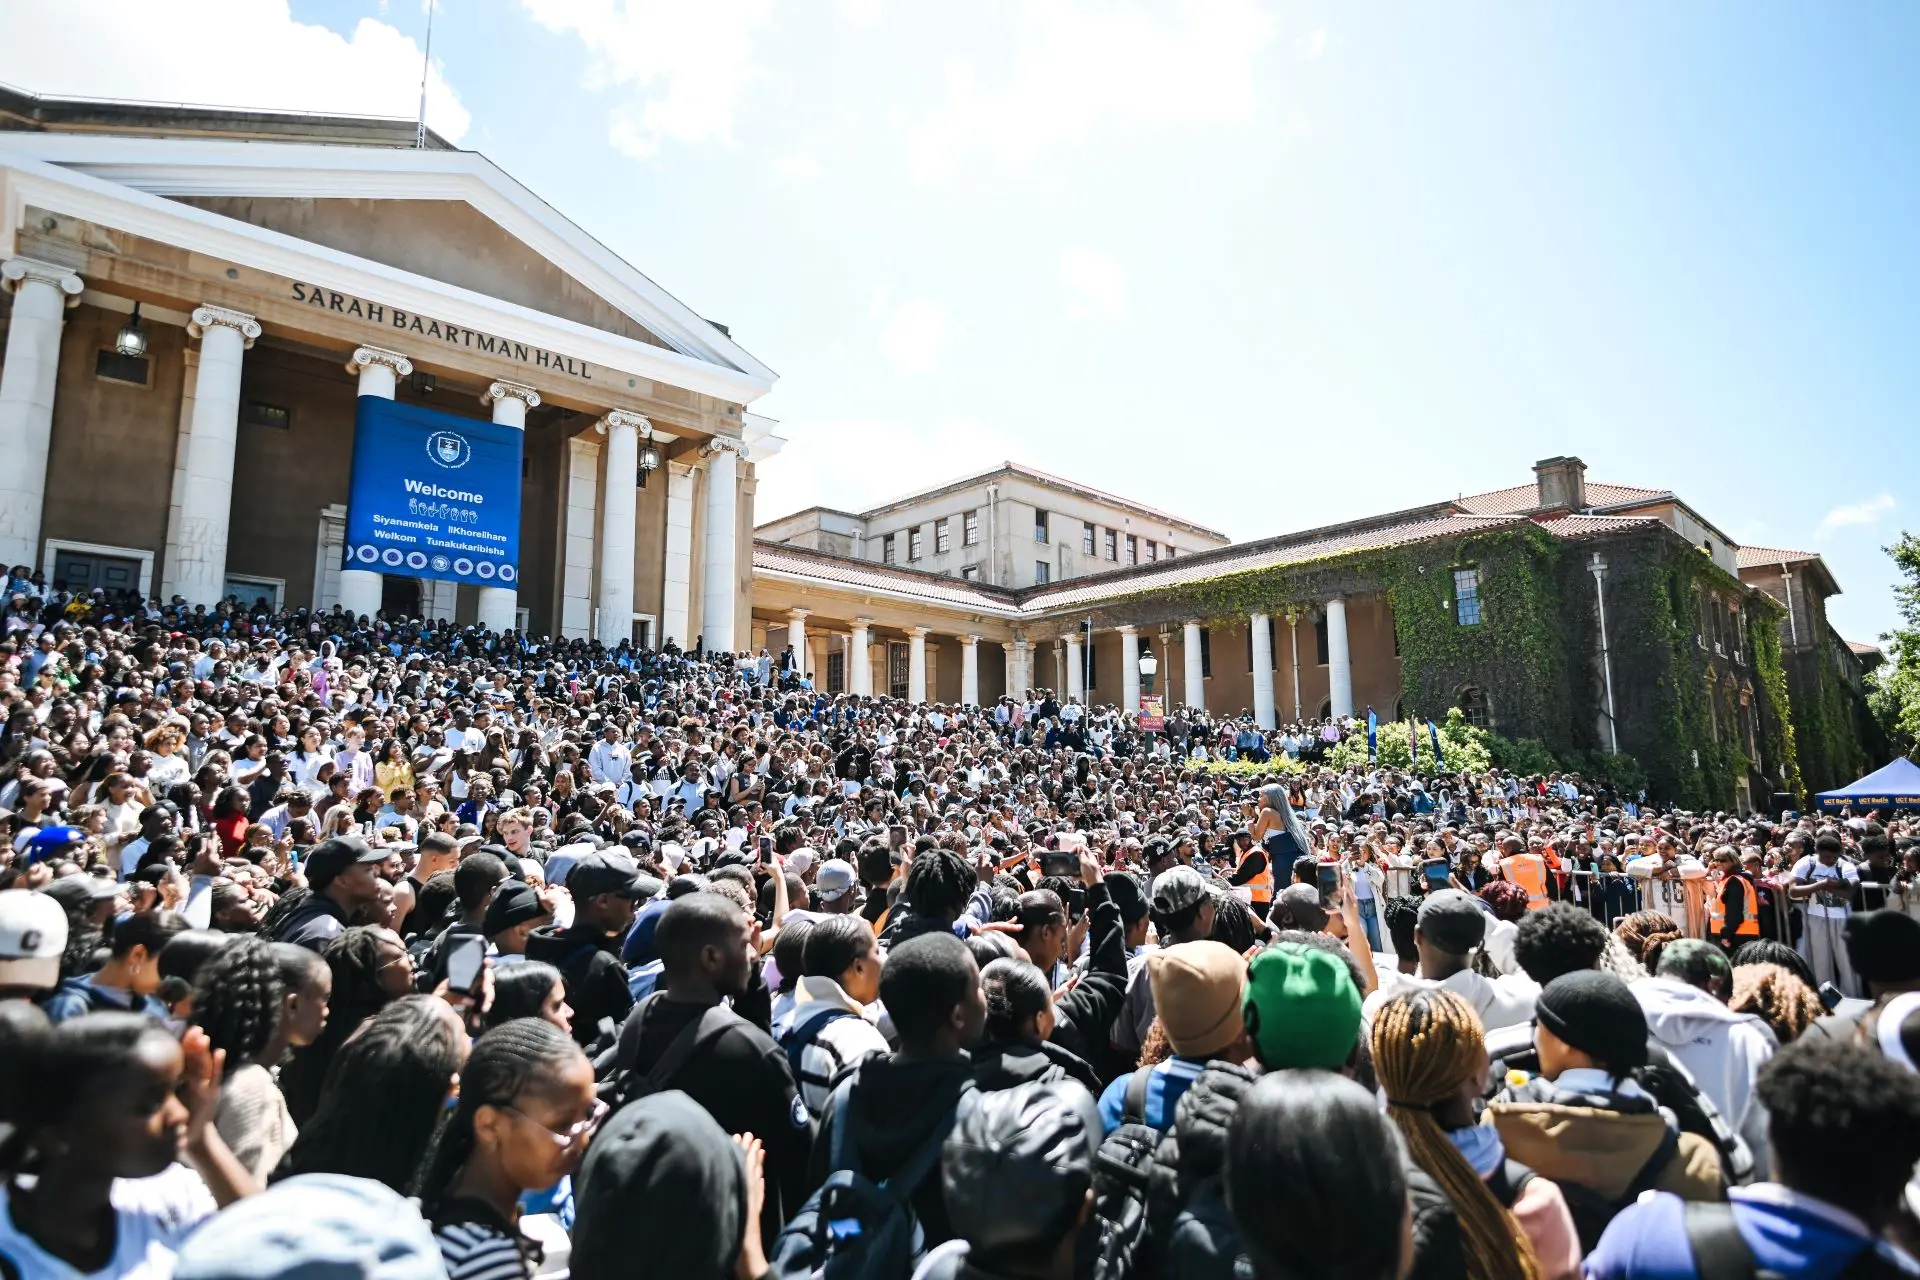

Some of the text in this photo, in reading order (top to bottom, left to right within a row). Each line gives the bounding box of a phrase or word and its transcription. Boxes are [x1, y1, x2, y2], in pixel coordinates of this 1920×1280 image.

[292, 282, 592, 379] SARAH BAARTMAN HALL
[403, 478, 484, 504] Welcome
[372, 513, 439, 532] Siyanamkela
[373, 529, 505, 556] Welkom Tunakukaribisha
[20, 929, 43, 952] C
